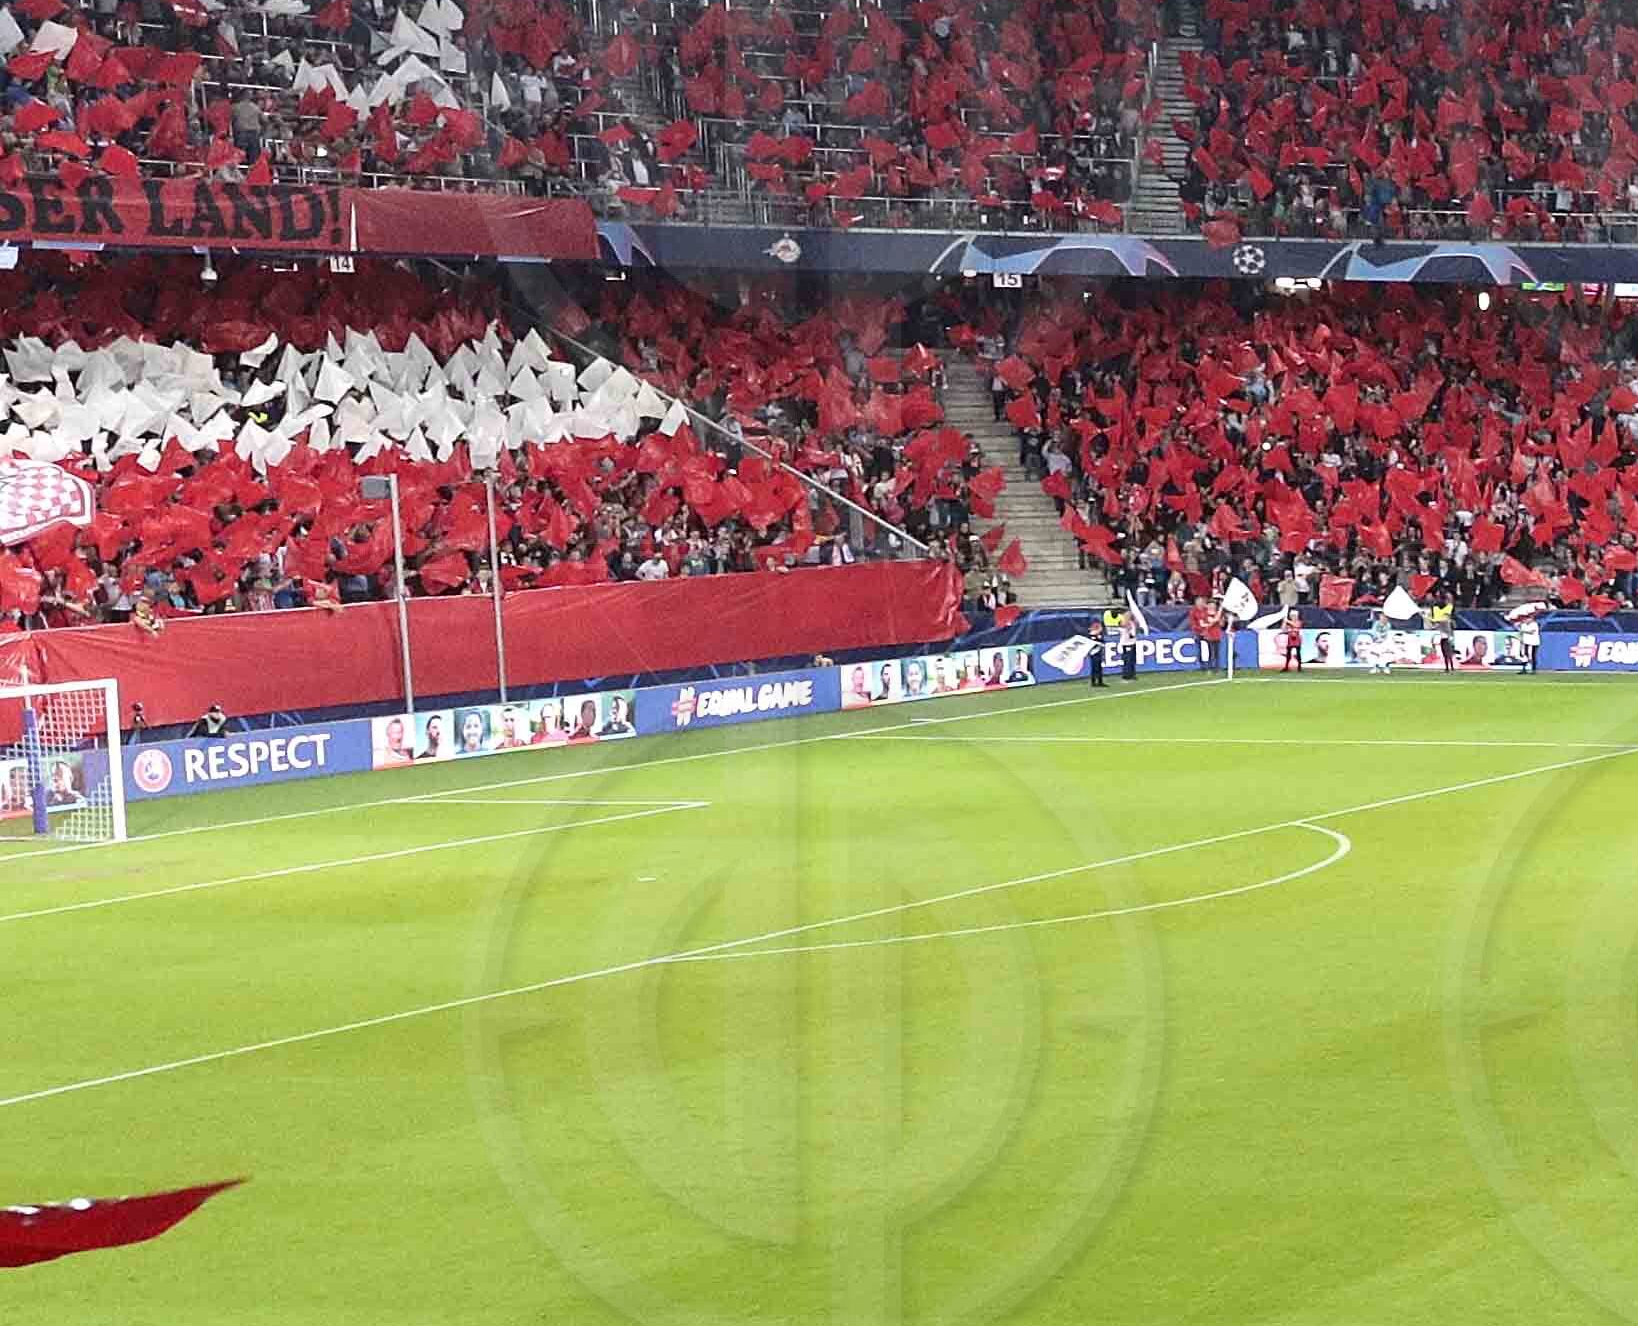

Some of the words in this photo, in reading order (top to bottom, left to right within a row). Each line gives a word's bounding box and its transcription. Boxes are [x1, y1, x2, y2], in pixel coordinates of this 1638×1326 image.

[143, 178, 346, 246] LAND!
[334, 258, 351, 271] 14
[998, 274, 1018, 287] 15
[184, 734, 331, 783] RESPECT
